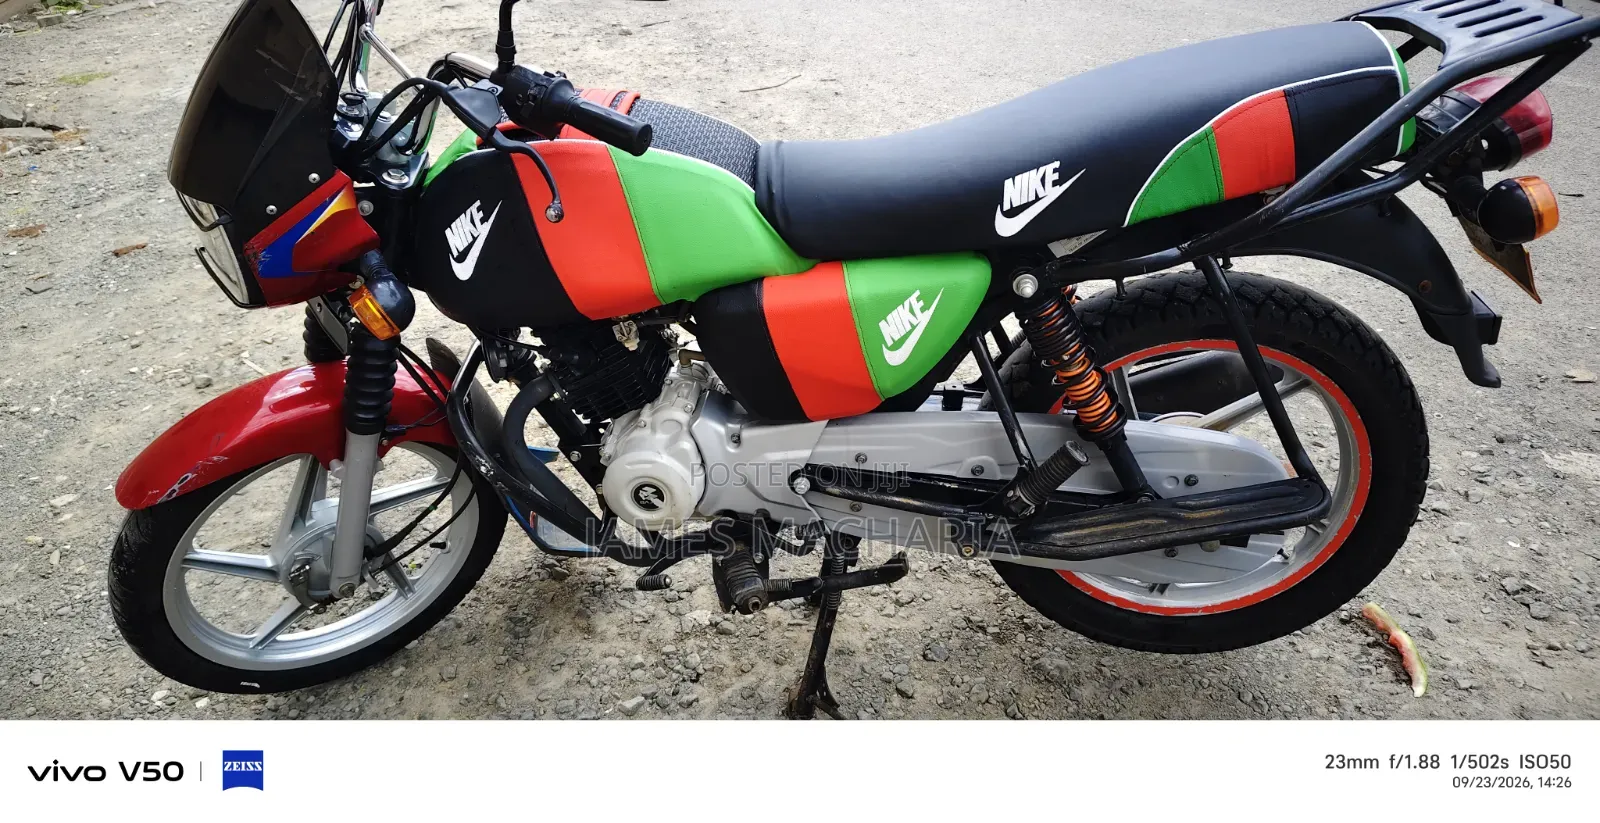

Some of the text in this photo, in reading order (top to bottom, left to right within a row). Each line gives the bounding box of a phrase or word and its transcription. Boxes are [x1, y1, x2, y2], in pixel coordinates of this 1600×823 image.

[1003, 160, 1060, 211] NIKE
[444, 199, 488, 258] NIKE
[878, 289, 929, 347] NIKE
